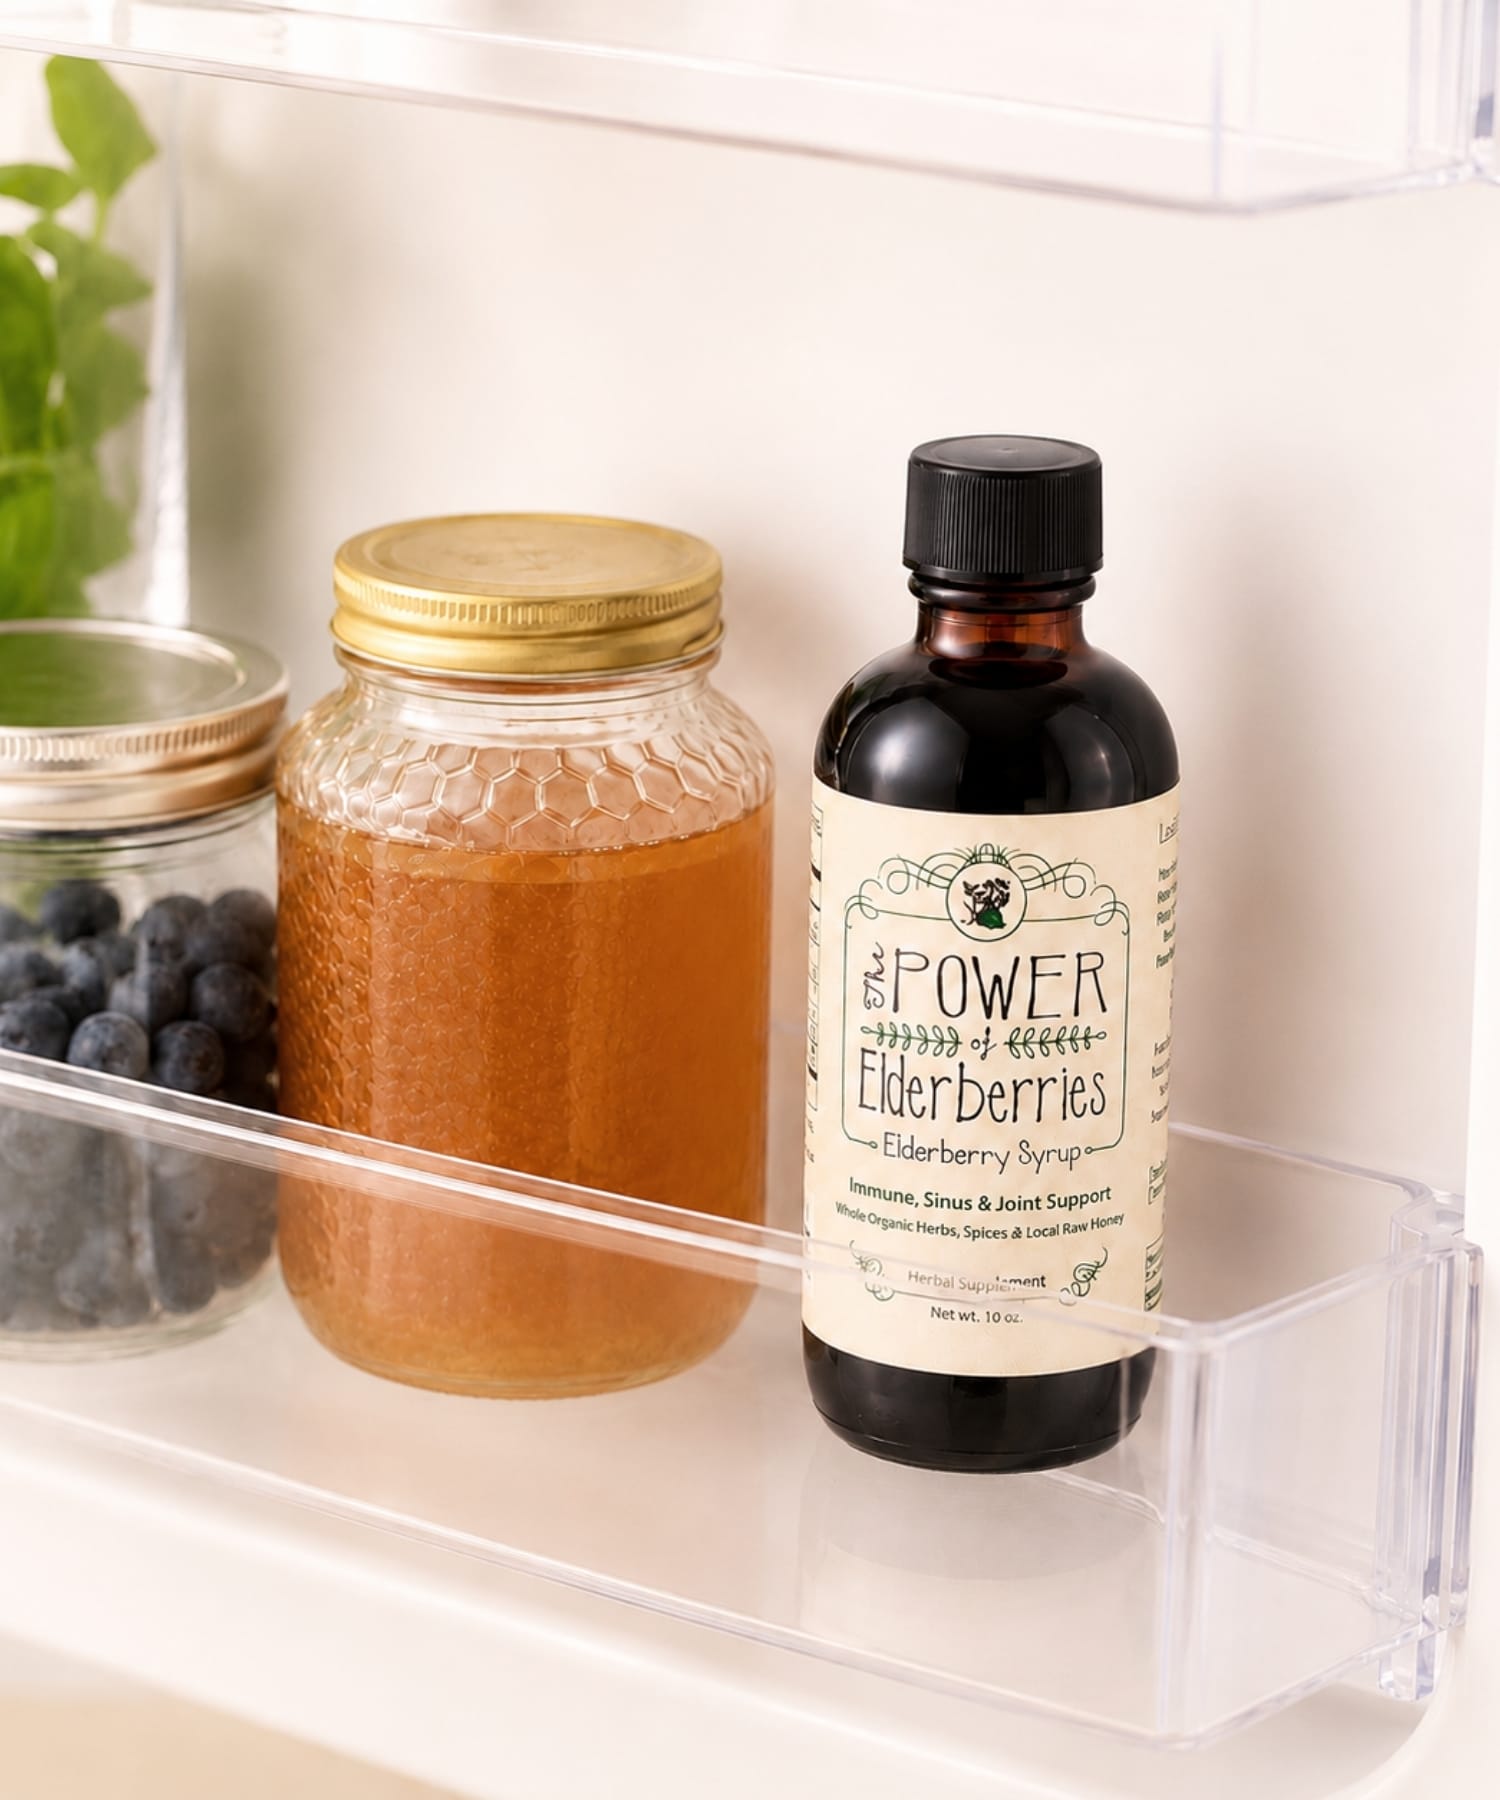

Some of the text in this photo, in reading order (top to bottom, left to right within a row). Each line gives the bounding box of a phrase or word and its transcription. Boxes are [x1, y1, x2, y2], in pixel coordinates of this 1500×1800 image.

[892, 948, 1107, 1020] POWER
[970, 1026, 997, 1060] of
[858, 1047, 1106, 1123] Elderberries
[1018, 1140, 1081, 1174] Syrup
[849, 1177, 1112, 1212] Immune, Sinus & Joint Support
[835, 1201, 867, 1222] Whole
[867, 1212, 914, 1231] Organic
[916, 1221, 960, 1239] Herbs,
[963, 1225, 1008, 1241] Spices
[1026, 1224, 1060, 1239] Local
[1062, 1221, 1088, 1235] Raw
[1090, 1213, 1125, 1230] Honey
[908, 1270, 955, 1289] Herbal
[930, 1306, 1024, 1323] Net wt. 10 oz.
